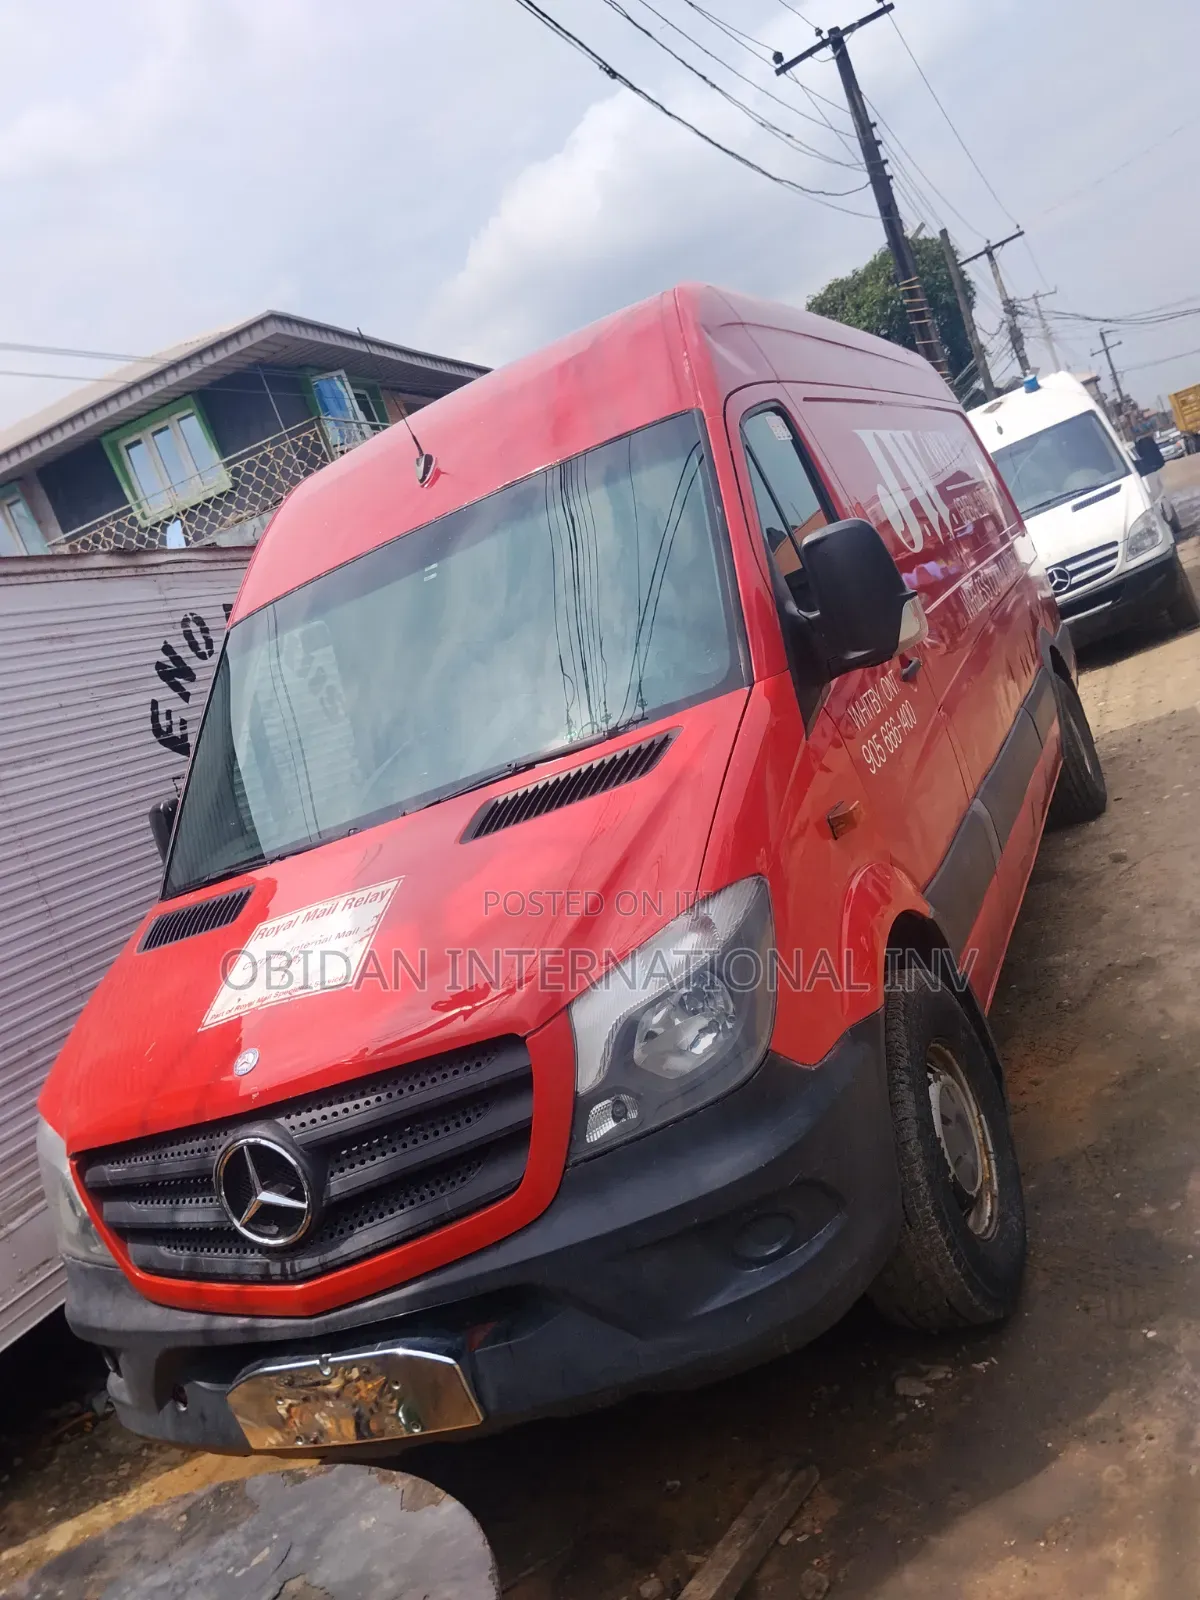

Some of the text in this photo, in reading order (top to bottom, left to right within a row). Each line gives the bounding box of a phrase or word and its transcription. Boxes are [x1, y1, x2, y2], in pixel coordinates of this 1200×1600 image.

[847, 684, 887, 731] WHITBY,
[861, 700, 917, 774] 905 666-1400
[254, 888, 391, 942] Royal Mail Relay
[290, 936, 332, 953] Internal
[335, 927, 360, 941] Mail
[210, 1011, 225, 1020] Part
[234, 1001, 255, 1013] Royal
[256, 994, 272, 1005] Mail
